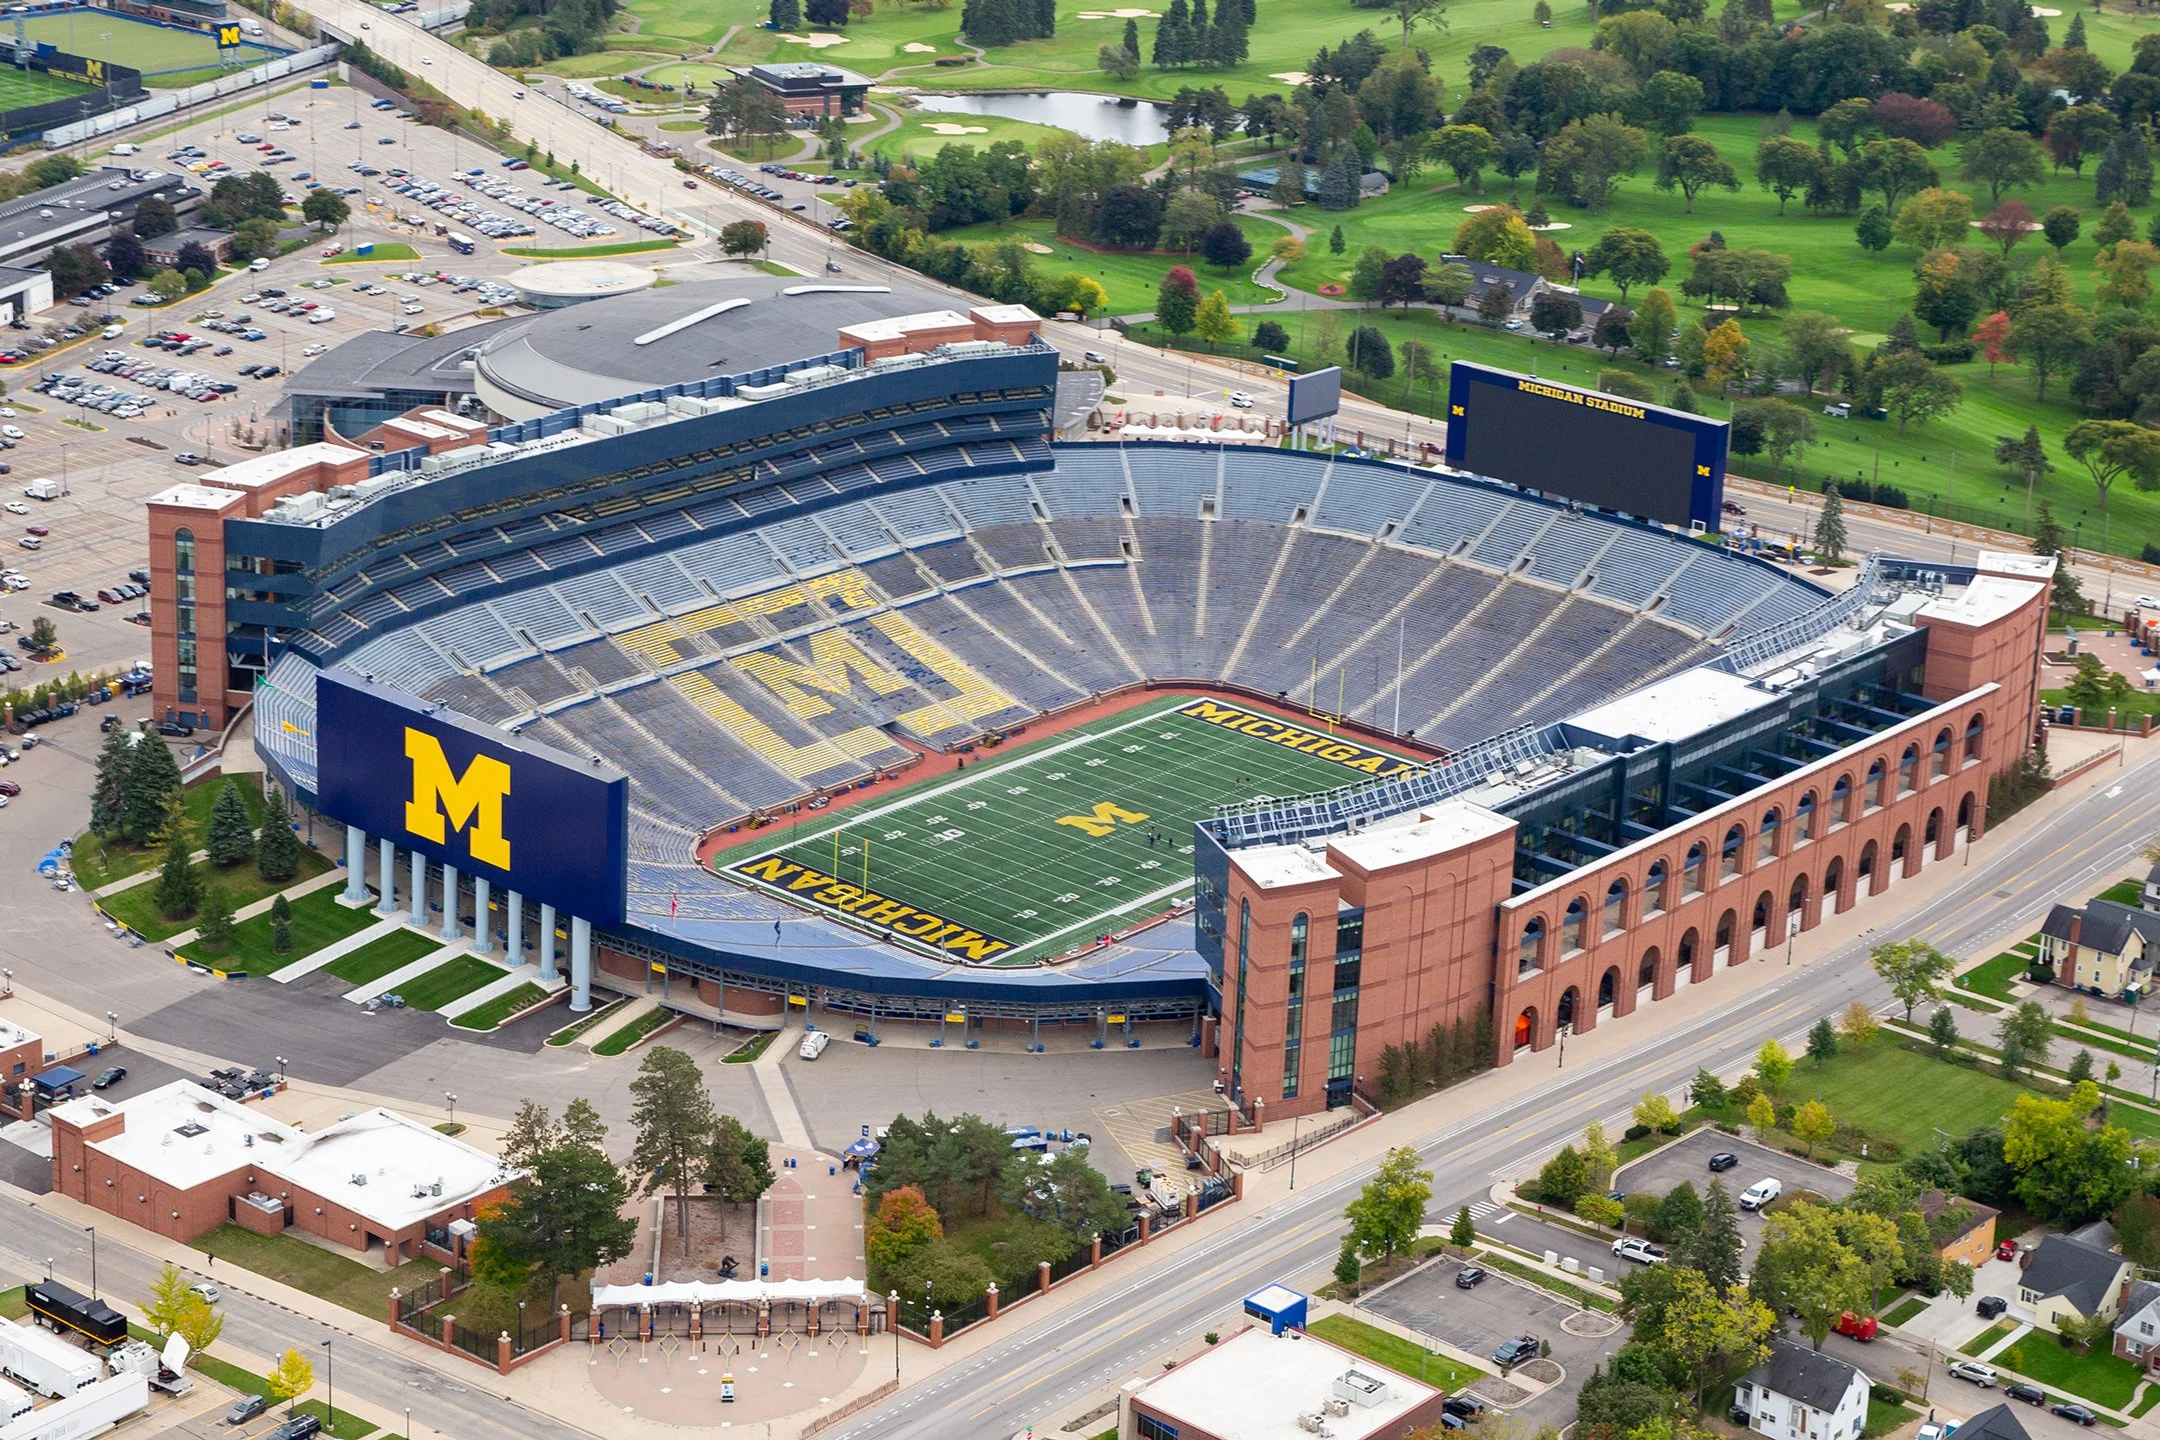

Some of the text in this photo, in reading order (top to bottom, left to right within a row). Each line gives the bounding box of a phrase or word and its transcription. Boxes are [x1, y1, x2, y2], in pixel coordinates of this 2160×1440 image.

[220, 26, 240, 45] M
[86, 59, 102, 78] M
[1452, 405, 1465, 417] M
[1518, 380, 1645, 419] MICHIGAN STADIUM
[1697, 465, 1710, 477] M
[404, 726, 511, 871] M
[1055, 800, 1150, 838] M
[740, 857, 1010, 961] MICHIGAN
